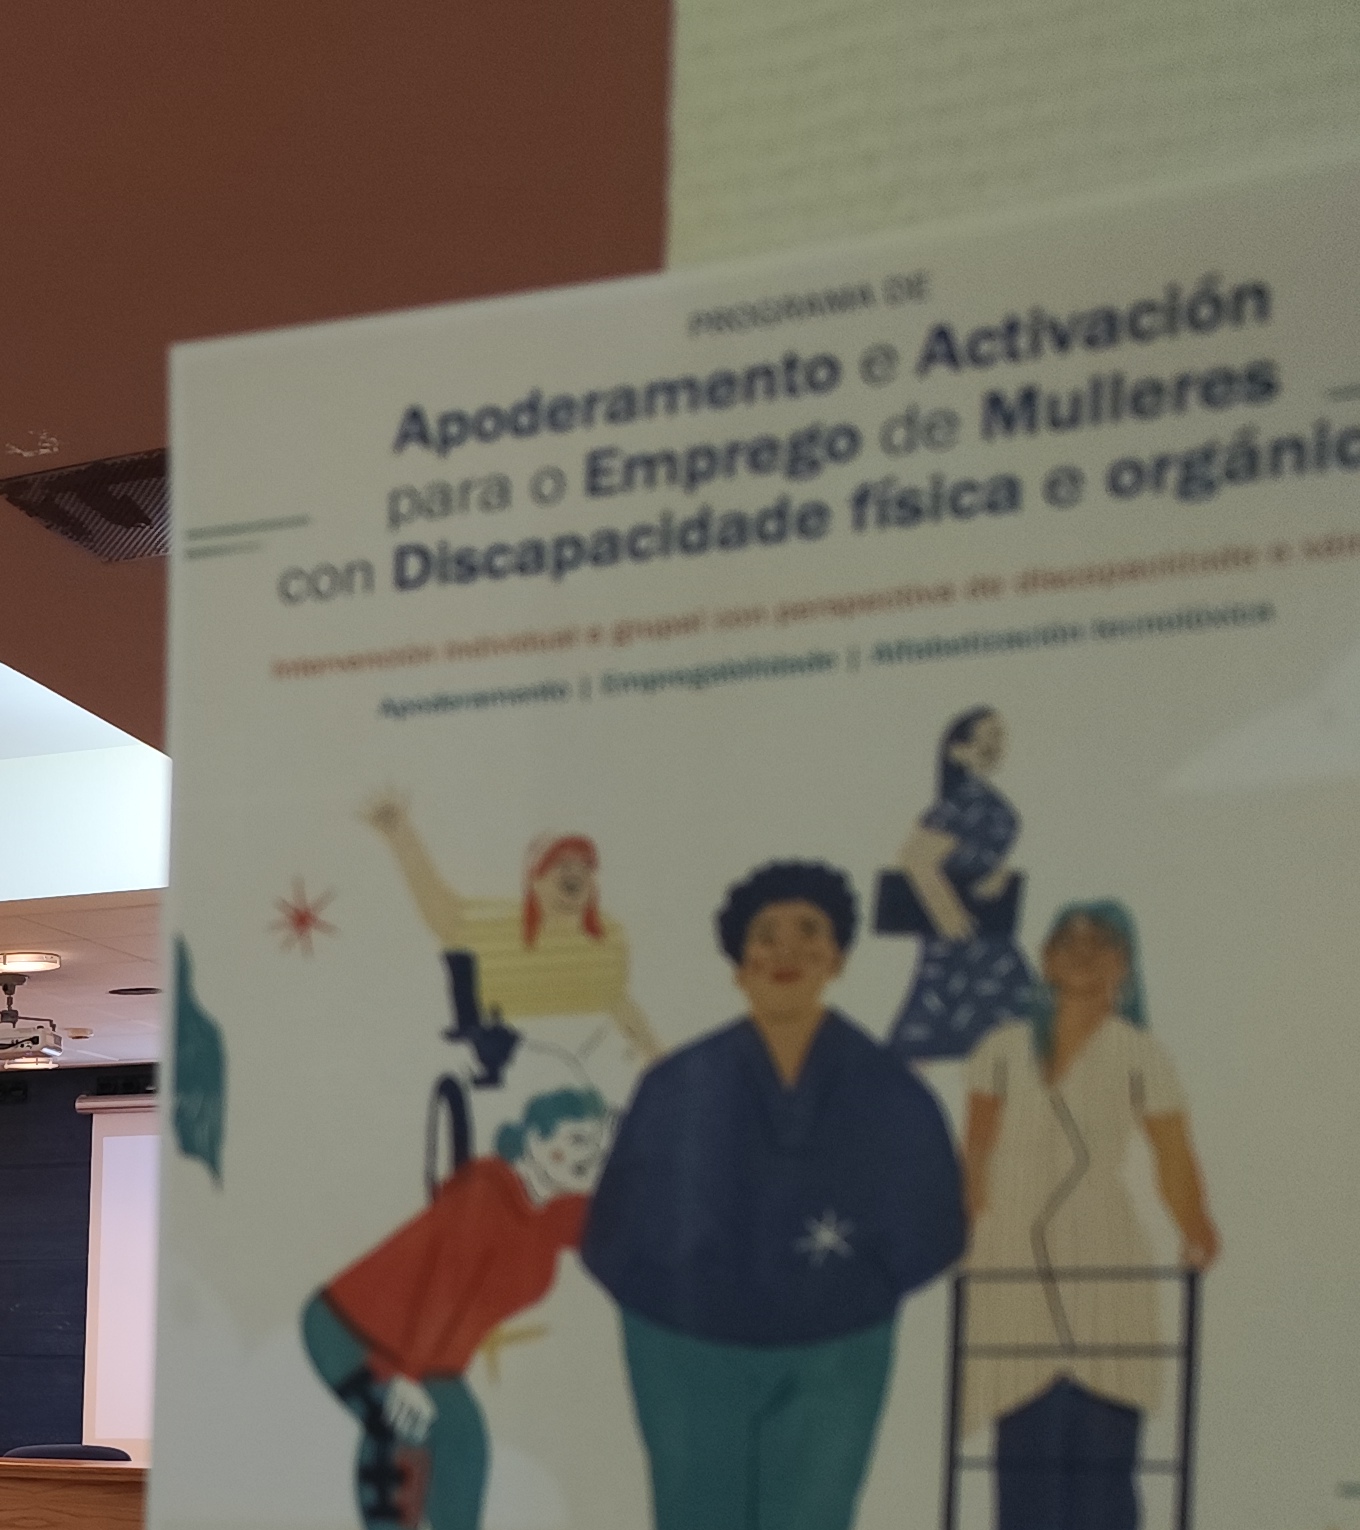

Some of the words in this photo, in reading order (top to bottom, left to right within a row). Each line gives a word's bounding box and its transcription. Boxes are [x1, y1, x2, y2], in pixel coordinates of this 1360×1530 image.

[393, 347, 842, 458] Apoderamento
[860, 345, 901, 388] e
[915, 270, 1273, 379] Activación
[883, 269, 932, 307] DE
[385, 468, 512, 530] para
[527, 465, 567, 506] o
[581, 422, 863, 501] Emprego
[877, 401, 960, 457] de
[978, 357, 1280, 443] Mulleres
[276, 557, 377, 605] con
[392, 494, 831, 593] Discapacidade
[848, 463, 1025, 531] física
[1041, 467, 1084, 509] e
